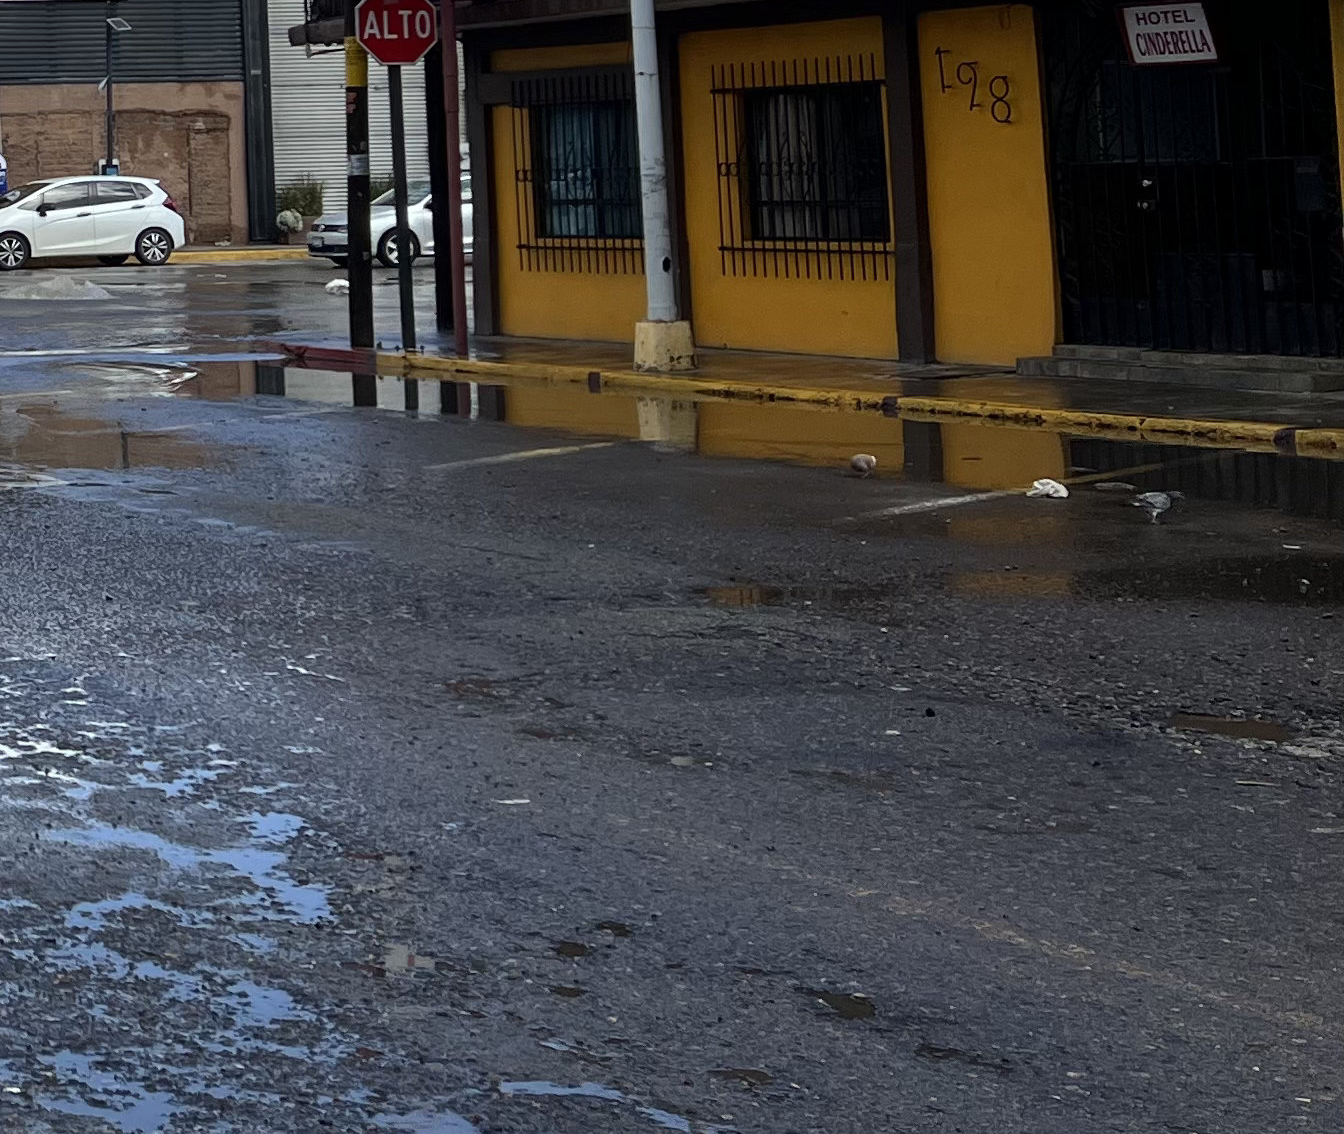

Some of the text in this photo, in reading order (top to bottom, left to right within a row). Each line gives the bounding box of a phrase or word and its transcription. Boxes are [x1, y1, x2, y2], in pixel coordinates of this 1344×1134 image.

[363, 9, 432, 40] ALTO
[1134, 9, 1196, 26] HOTEL
[1135, 29, 1212, 57] CINDERELLA
